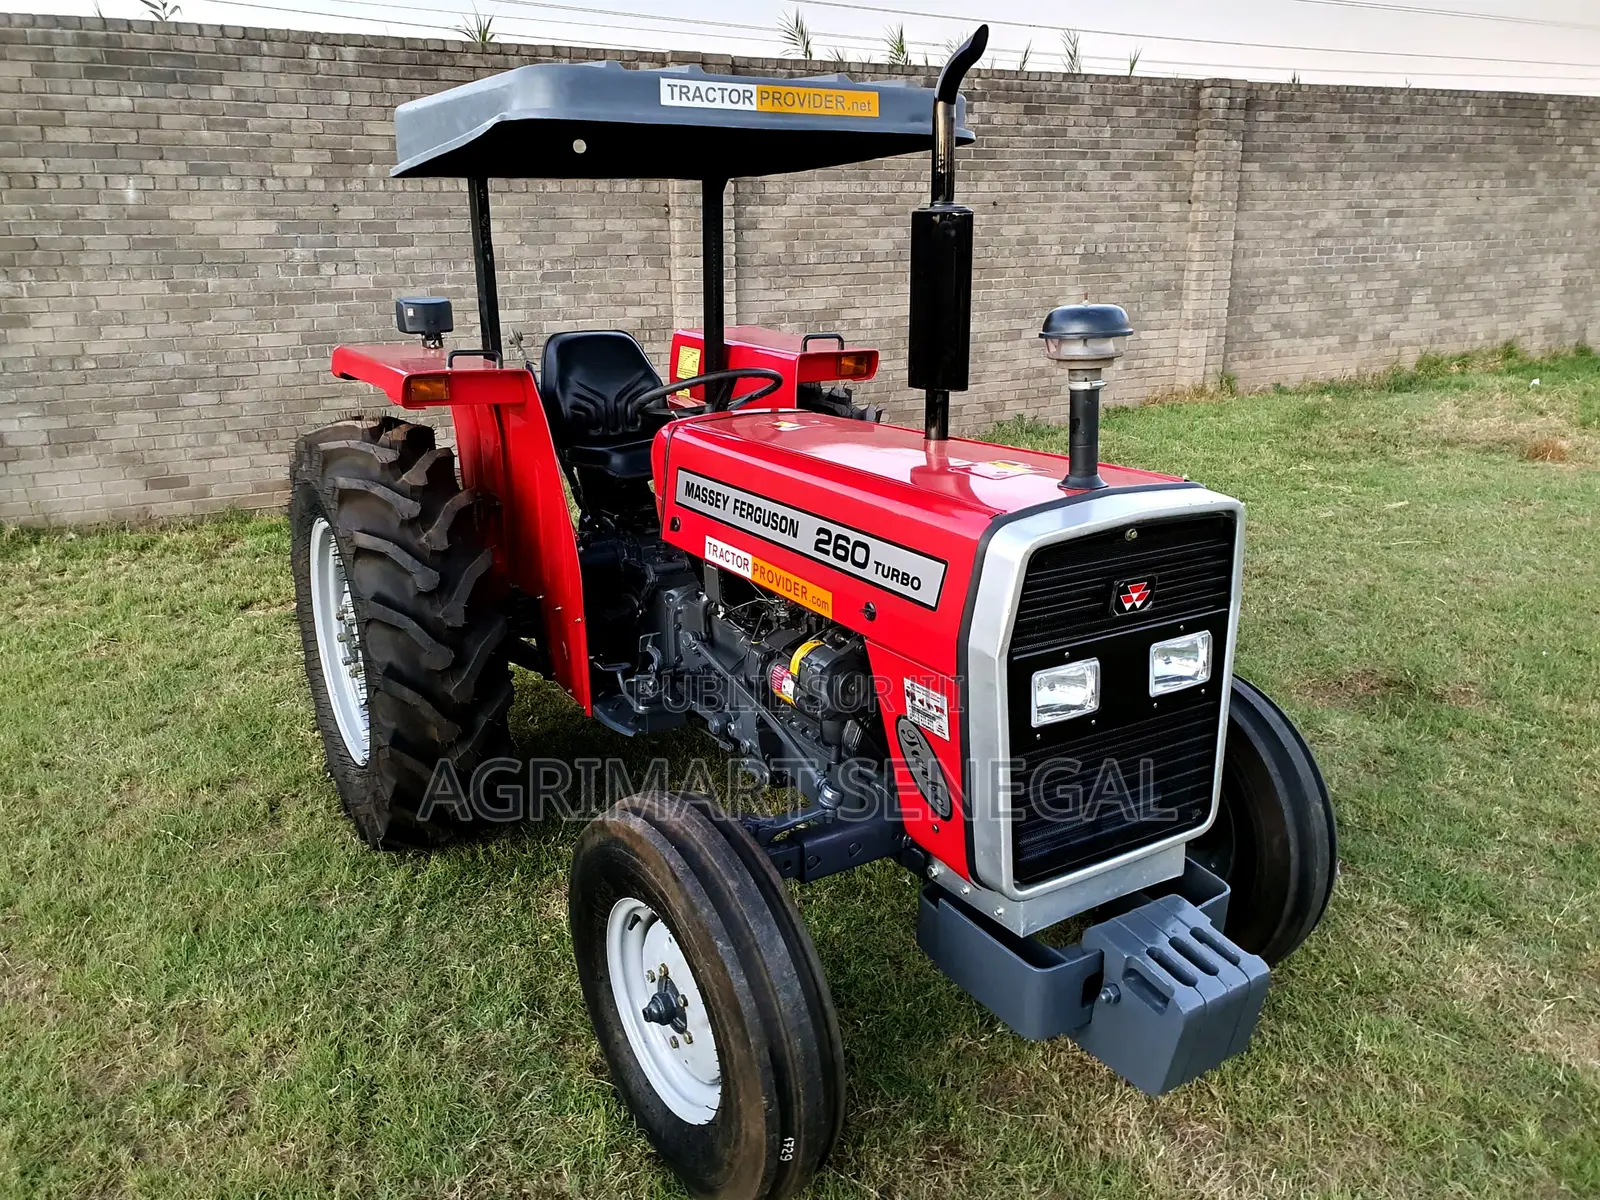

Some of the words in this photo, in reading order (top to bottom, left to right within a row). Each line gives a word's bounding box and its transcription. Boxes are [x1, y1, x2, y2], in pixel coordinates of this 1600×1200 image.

[667, 83, 754, 106] TRACTOR
[685, 480, 730, 511] MASSEY
[732, 499, 800, 539] FERGUSON
[813, 527, 871, 570] 260
[874, 560, 922, 591] TURBO
[707, 541, 750, 572] TRACTOR
[779, 1136, 795, 1162] 1729
